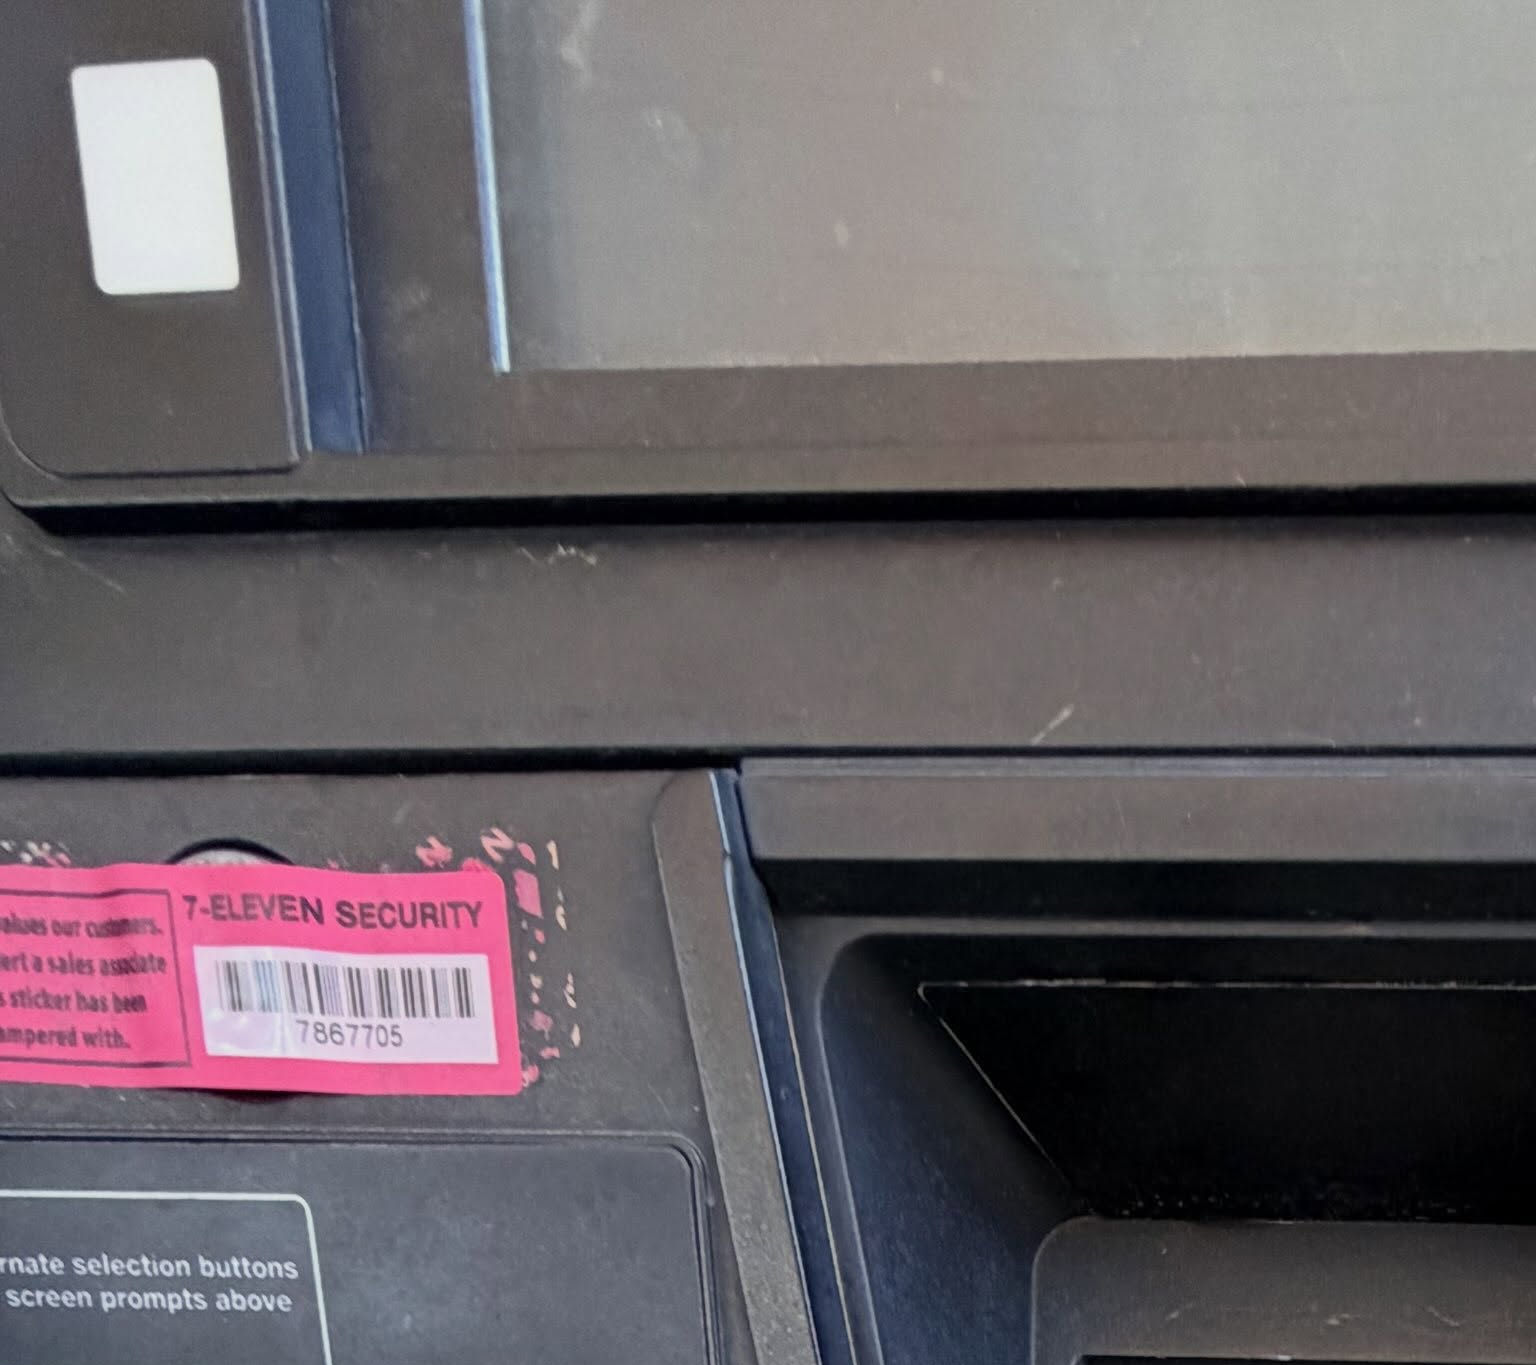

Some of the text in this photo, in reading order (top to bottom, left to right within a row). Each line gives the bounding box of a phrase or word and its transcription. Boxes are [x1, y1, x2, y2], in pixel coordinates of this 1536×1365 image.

[182, 894, 483, 929] 7-ELEVEN SECURITY
[296, 1020, 404, 1047] 7867705
[71, 1252, 192, 1278] selection
[198, 1254, 299, 1281] buttons
[5, 1287, 293, 1314] screen prompts above
